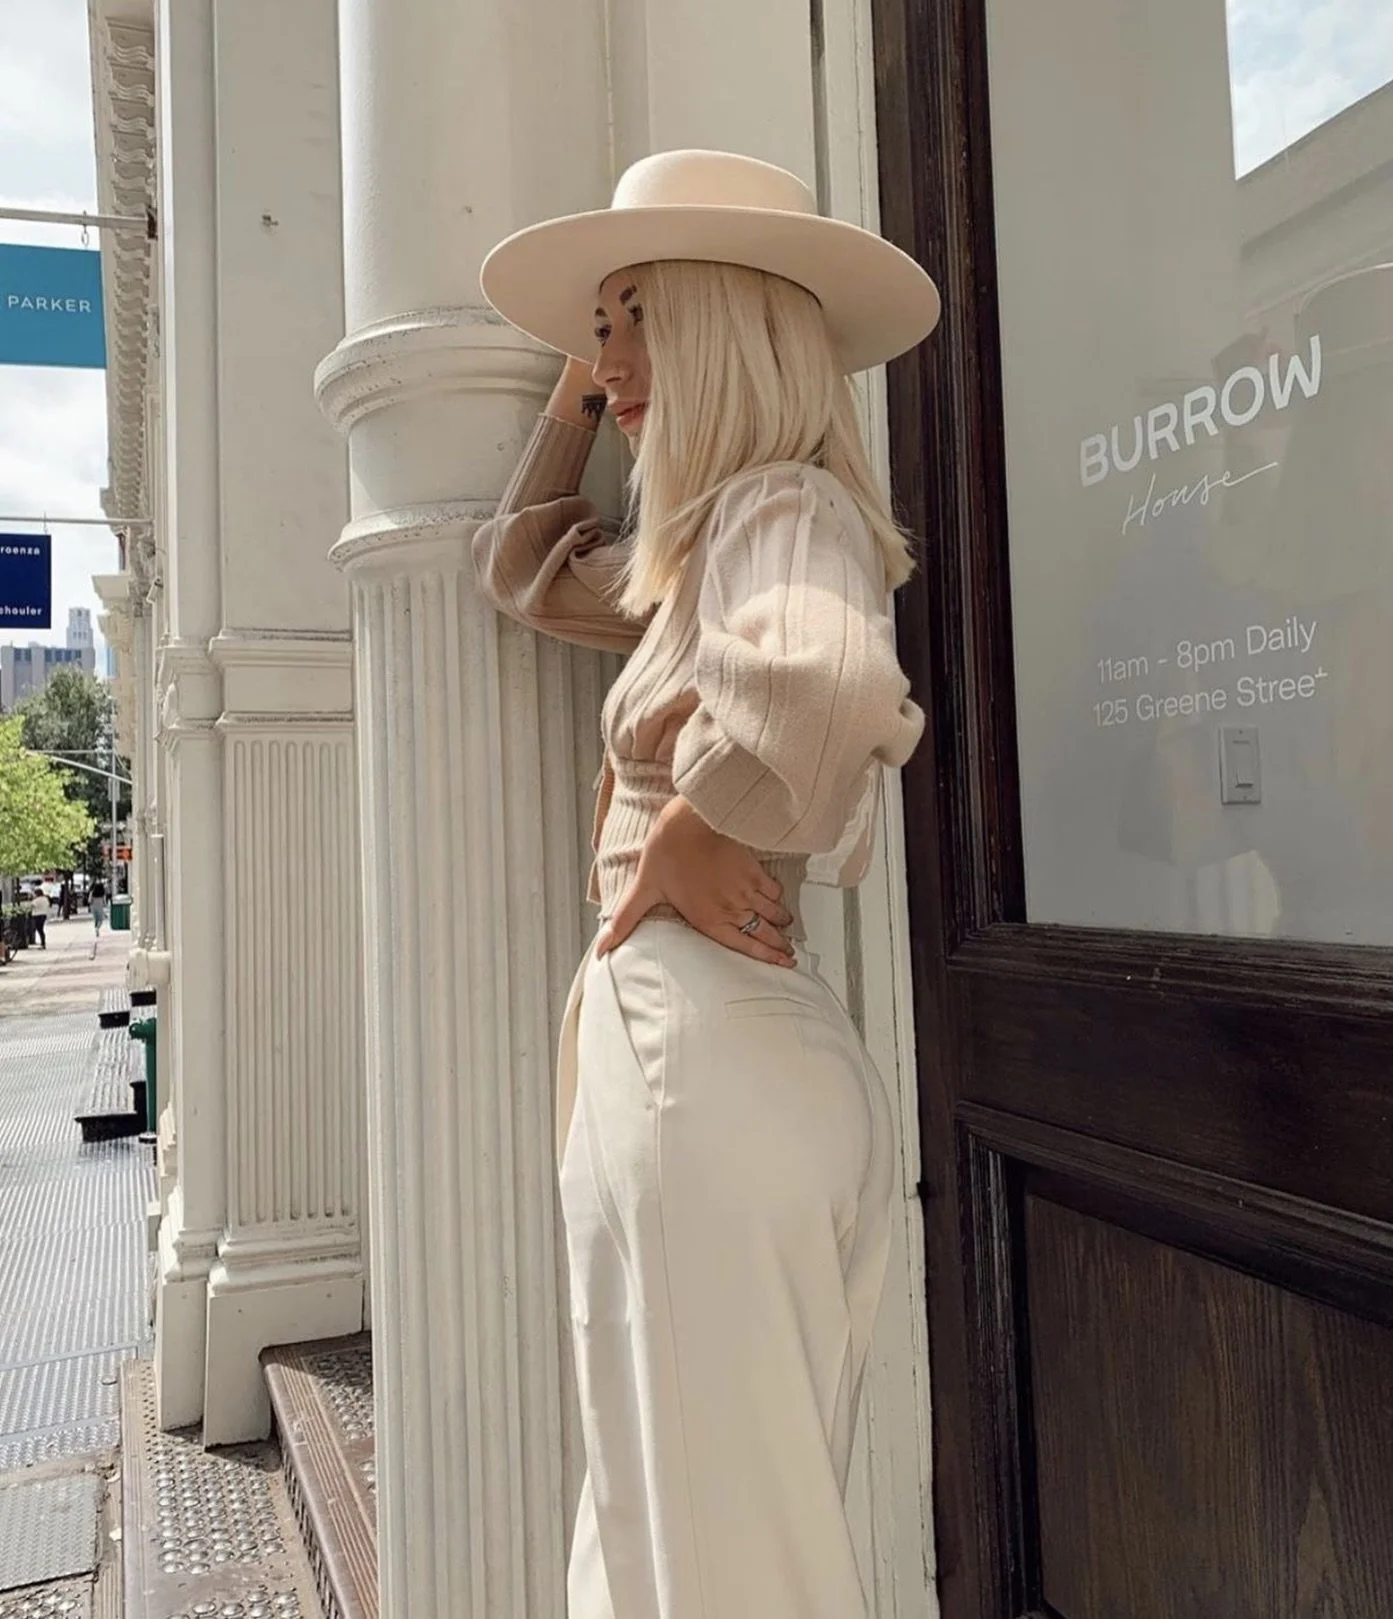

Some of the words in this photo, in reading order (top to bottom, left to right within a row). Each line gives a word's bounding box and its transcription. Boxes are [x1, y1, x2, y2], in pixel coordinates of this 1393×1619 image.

[8, 295, 91, 312] PARKER
[1079, 334, 1322, 488] BURROW
[1122, 461, 1279, 535] House
[1097, 656, 1148, 683] 11am
[1176, 637, 1235, 672] 8pm
[1246, 616, 1317, 655] Daily
[1093, 699, 1128, 727] 125
[1136, 688, 1227, 722] Greene
